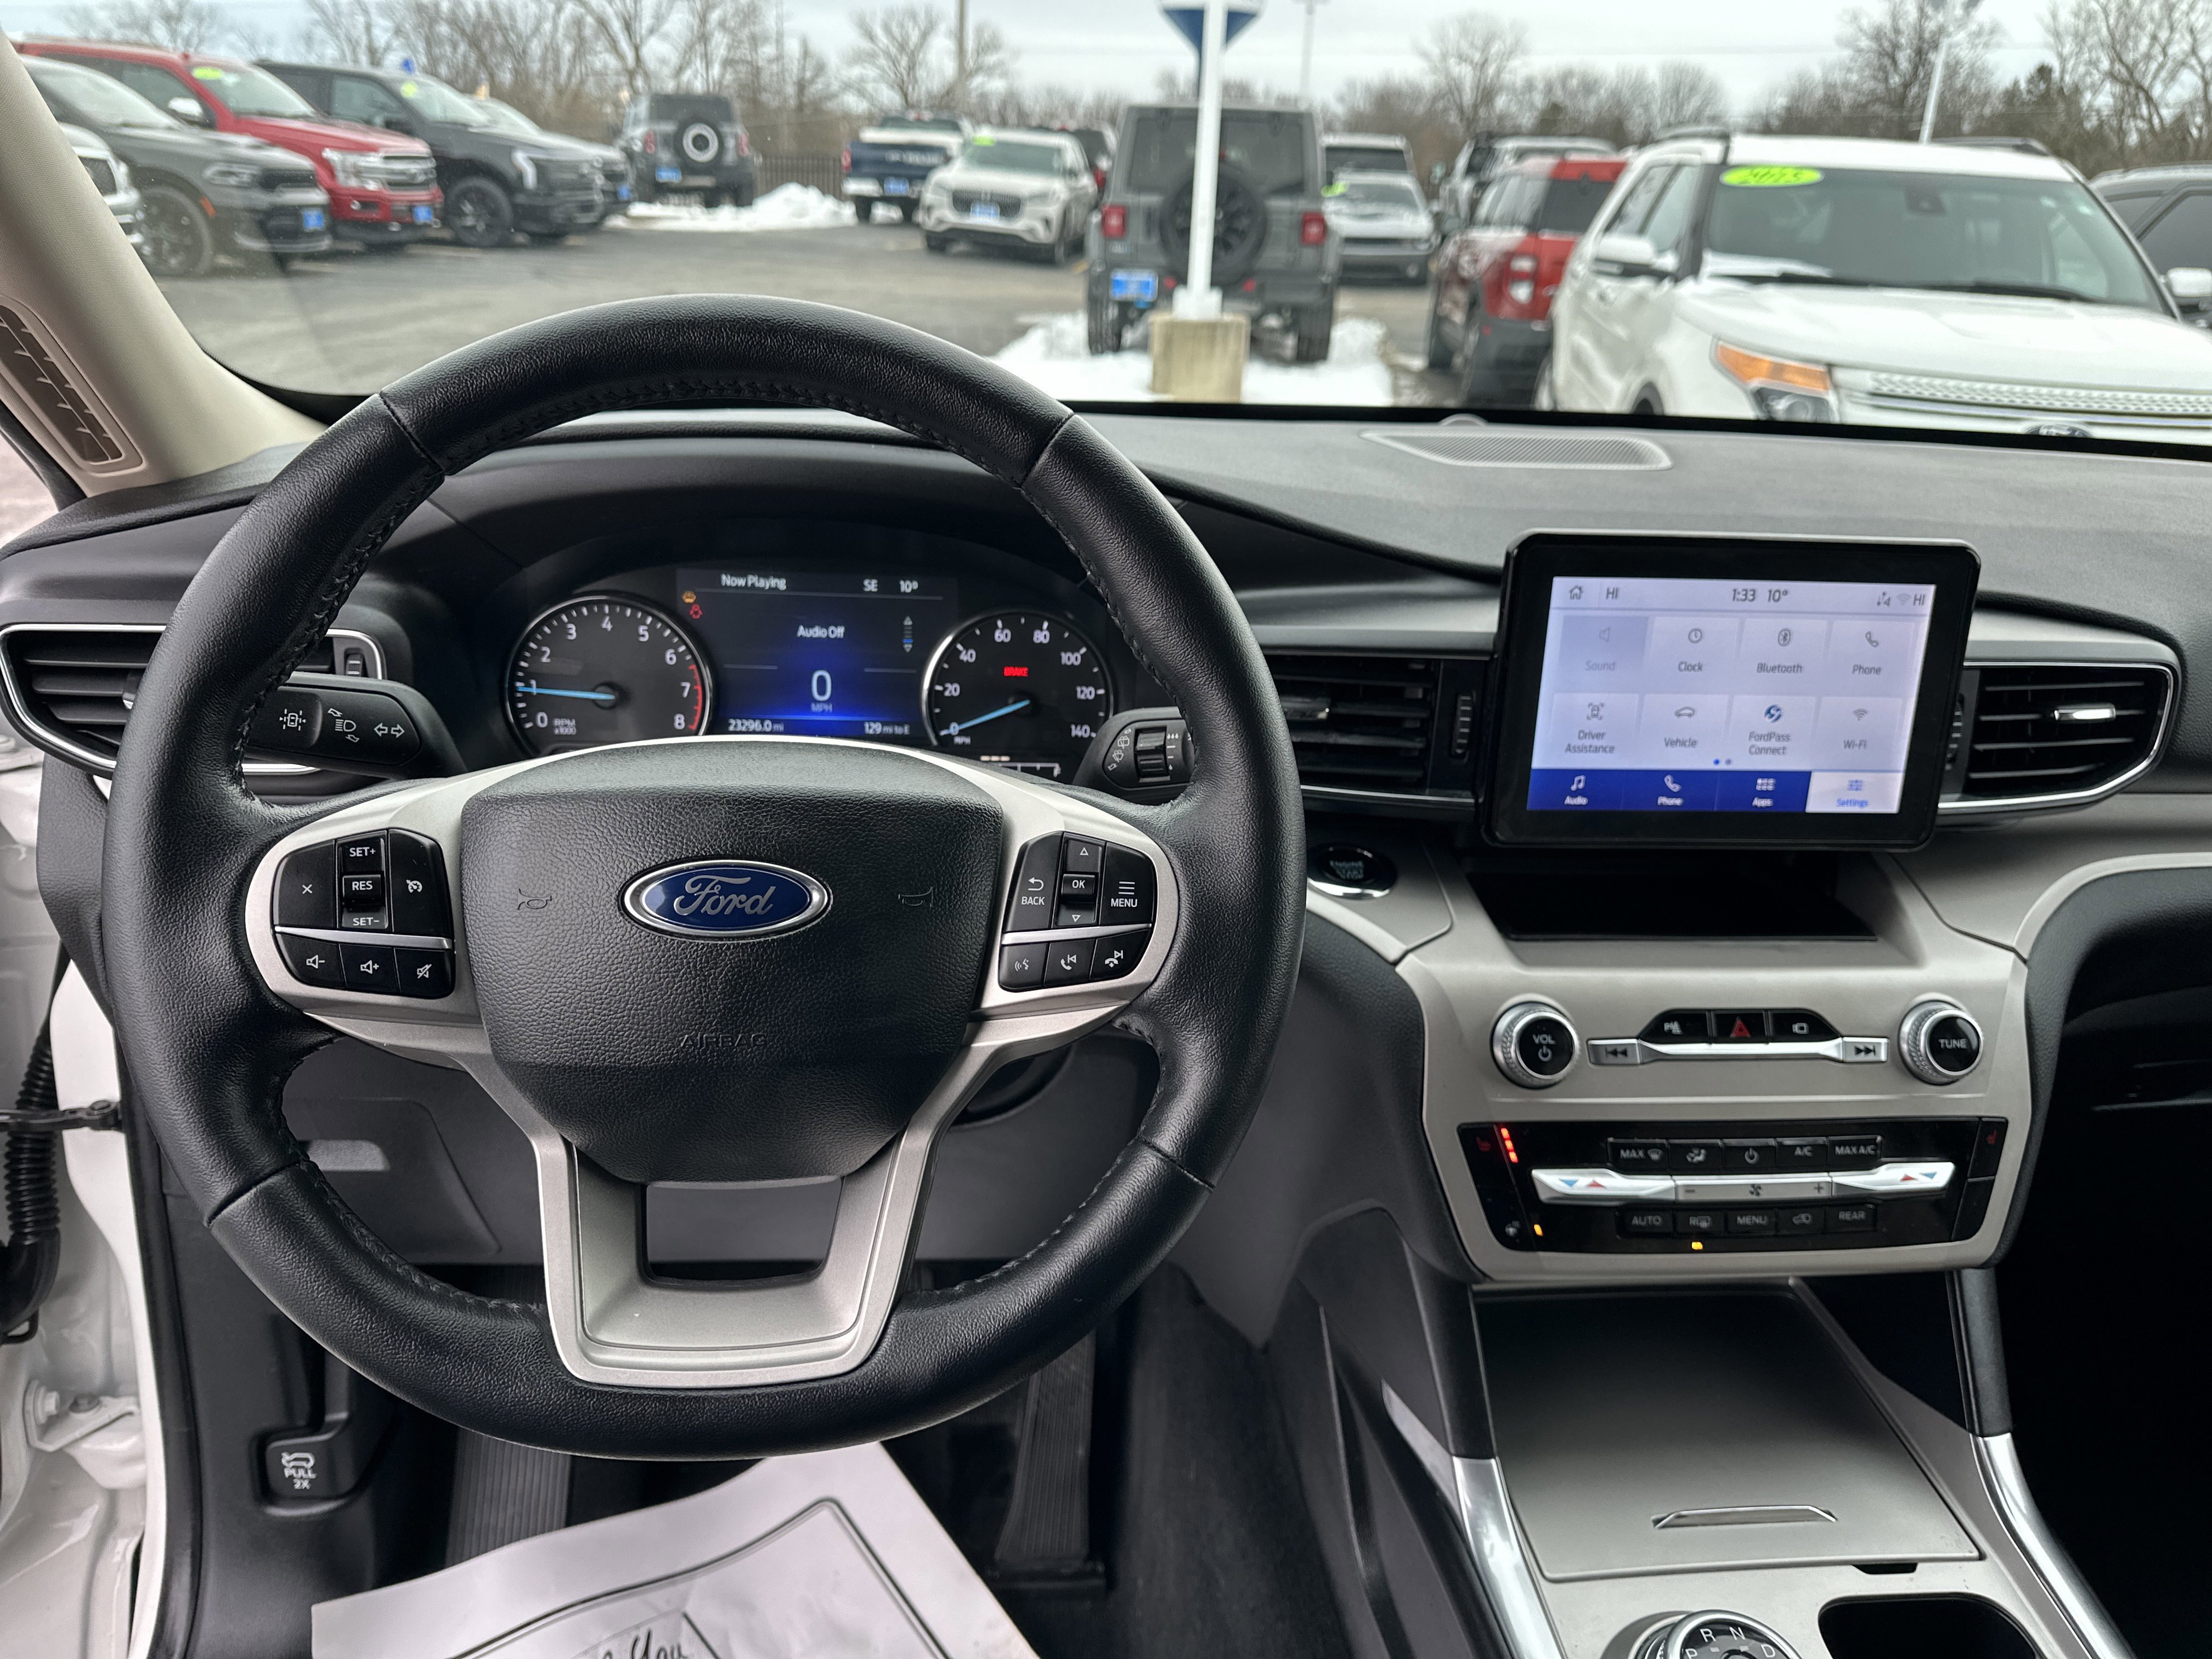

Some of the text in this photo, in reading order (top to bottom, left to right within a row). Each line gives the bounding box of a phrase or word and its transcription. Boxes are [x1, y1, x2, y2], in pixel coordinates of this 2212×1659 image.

[721, 574, 787, 590] Now Playing
[864, 579, 878, 592] SE
[1606, 587, 1618, 600] HI
[1732, 588, 1756, 602] 1:33
[1913, 594, 1925, 606] HI
[601, 616, 612, 631] 4
[567, 624, 577, 640] 3
[638, 625, 649, 642] 5
[797, 625, 845, 639] Audio Off
[995, 629, 1012, 642] 60
[1033, 629, 1049, 644] 80
[541, 647, 551, 663] 2
[665, 649, 676, 665] 6
[959, 649, 976, 663] 40
[1060, 652, 1081, 665] 100
[1004, 667, 1028, 677] BRAKE
[1585, 661, 1616, 672] Sound
[1678, 661, 1703, 673] Clock
[1756, 662, 1802, 674] Bluetooth
[1852, 664, 1882, 675] Phone
[681, 682, 691, 698] 7
[811, 670, 832, 701] 0
[944, 683, 960, 697] 20
[1076, 686, 1095, 700] 120
[811, 703, 832, 713] MPH
[535, 712, 548, 728] 0
[553, 718, 576, 727] RPM
[674, 714, 685, 730] 8
[728, 719, 784, 732] 23296.0 mi
[864, 722, 910, 735] 129 mi to E
[1070, 725, 1090, 739] 140
[953, 737, 970, 745] MPH
[1577, 730, 1606, 741] Driver
[1748, 731, 1791, 743] FordPass
[1564, 742, 1615, 754] Assistance
[1664, 737, 1697, 749] Vehicle
[1843, 739, 1867, 750] Wi-Fi
[1748, 744, 1786, 756] Connect
[1565, 795, 1588, 806] Audio
[1657, 796, 1683, 806] Phone
[1752, 797, 1773, 808] Apps
[1837, 798, 1869, 809] Settings
[349, 847, 376, 857] SET+
[352, 881, 373, 890] RES
[1072, 879, 1085, 889] OK
[673, 874, 776, 915] Ford
[1022, 896, 1045, 905] BACK
[1111, 899, 1137, 907] MENU
[680, 1033, 766, 1047] AIRBAG
[1533, 1034, 1555, 1045] VOL
[1939, 1039, 1967, 1049] TUNE
[1620, 1150, 1644, 1159] MAX
[1795, 1147, 1813, 1156] A/C
[1835, 1145, 1876, 1155] MAX A/C
[1632, 1215, 1663, 1226] AUTO
[1737, 1215, 1768, 1225] MENU
[1838, 1211, 1865, 1221] REAR
[284, 1468, 316, 1479] PULL
[293, 1479, 311, 1489] 2X
[1700, 1628, 1717, 1642] R
[1729, 1627, 1746, 1640] N
[1685, 1648, 1698, 1659] P
[1760, 1644, 1776, 1658] D
